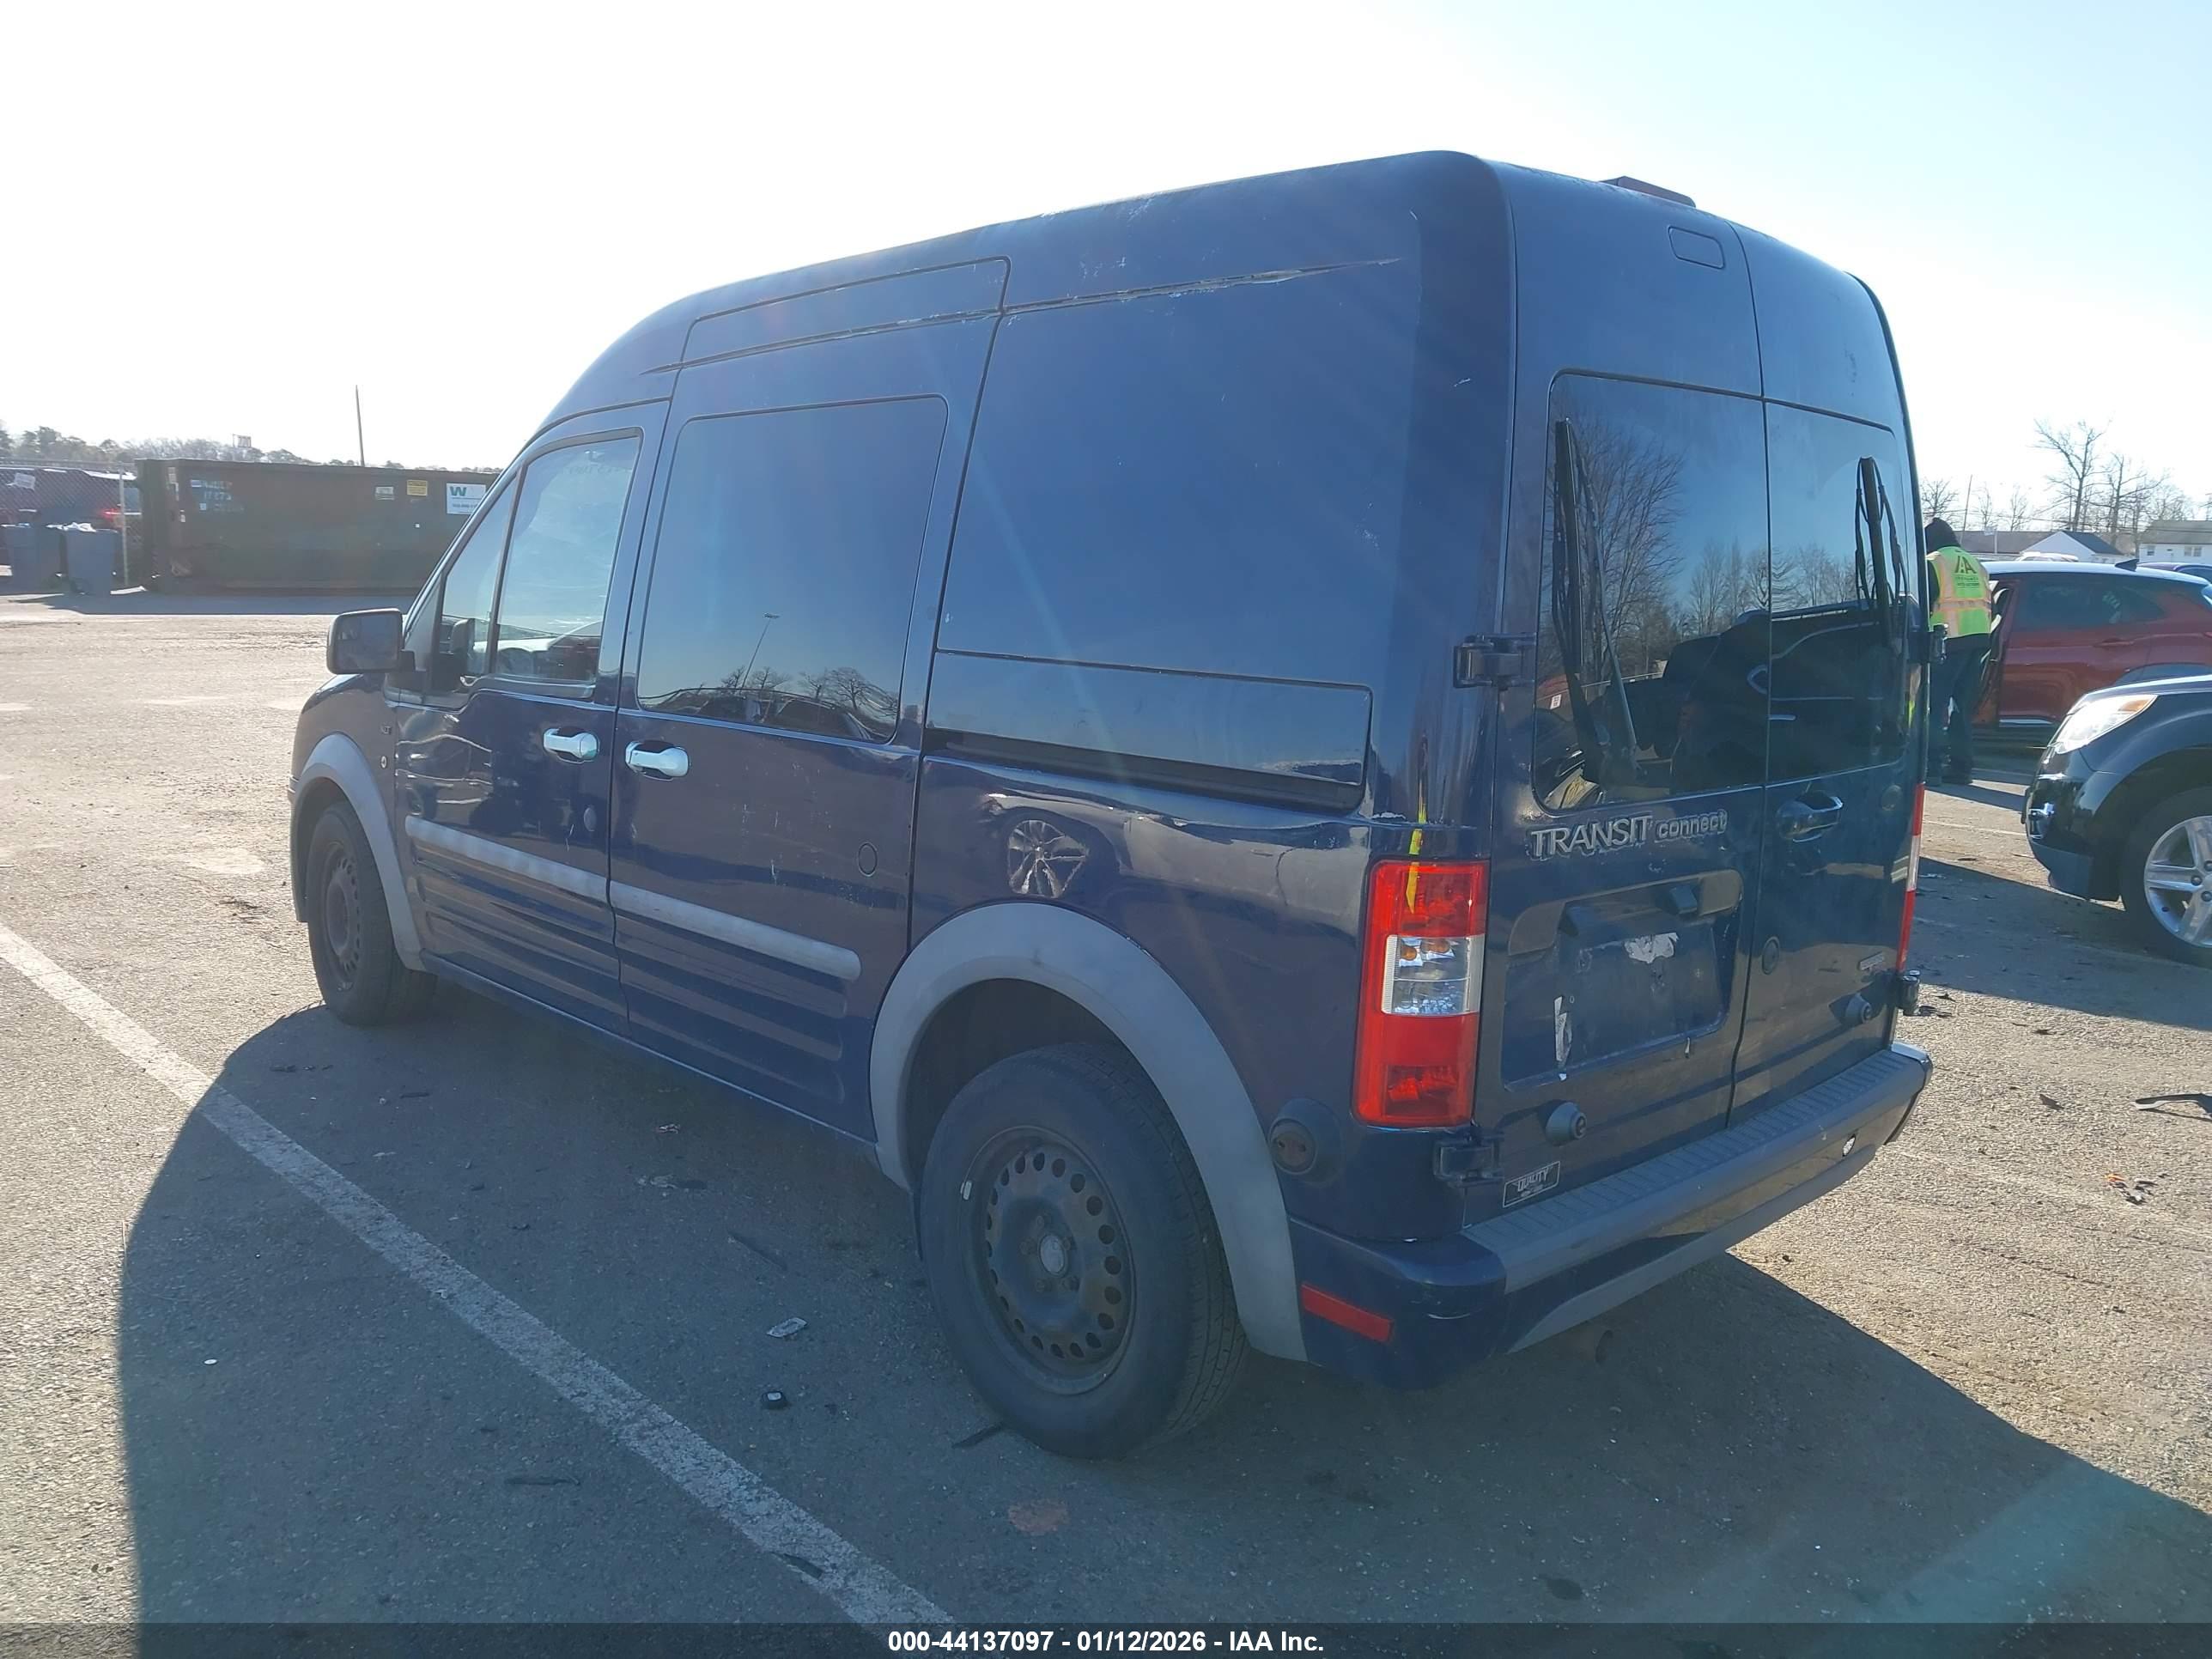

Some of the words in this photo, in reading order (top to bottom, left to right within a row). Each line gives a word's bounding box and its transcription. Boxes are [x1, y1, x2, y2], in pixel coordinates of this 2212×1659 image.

[1530, 815, 1654, 858] TRANSIT
[1659, 810, 1729, 840] connect
[1517, 1167, 1549, 1193] QUALITY
